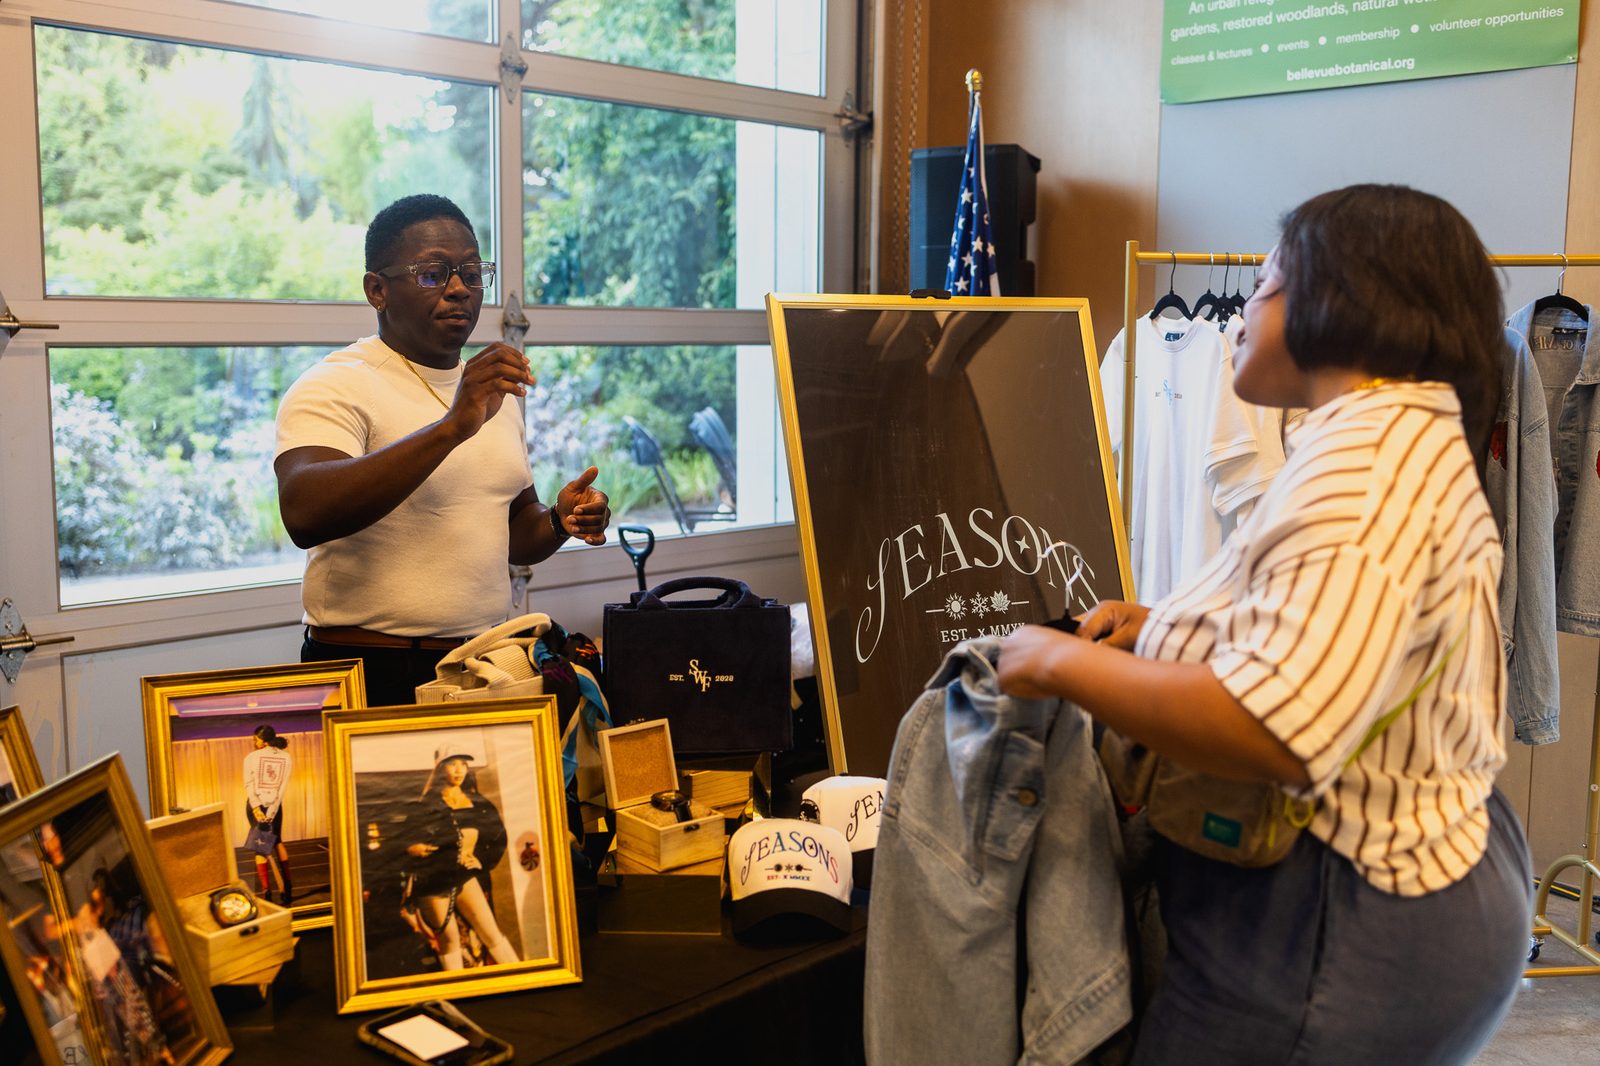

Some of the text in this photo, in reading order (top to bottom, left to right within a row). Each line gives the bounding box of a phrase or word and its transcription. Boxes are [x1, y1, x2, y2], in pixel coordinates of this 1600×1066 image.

[1170, 23, 1220, 41] gardens,
[1223, 12, 1272, 31] restored
[1276, 3, 1348, 23] woodlands,
[1188, 2, 1204, 14] An
[1171, 54, 1205, 65] classes
[1216, 47, 1253, 60] lectures
[1277, 40, 1310, 52] events
[1336, 27, 1400, 44] membership
[1430, 18, 1482, 32] volunteer
[1485, 7, 1564, 26] opportunities
[1286, 58, 1415, 80] bellevuebotanical.org
[941, 628, 972, 643] EST.
[741, 831, 838, 885] SEASONS
